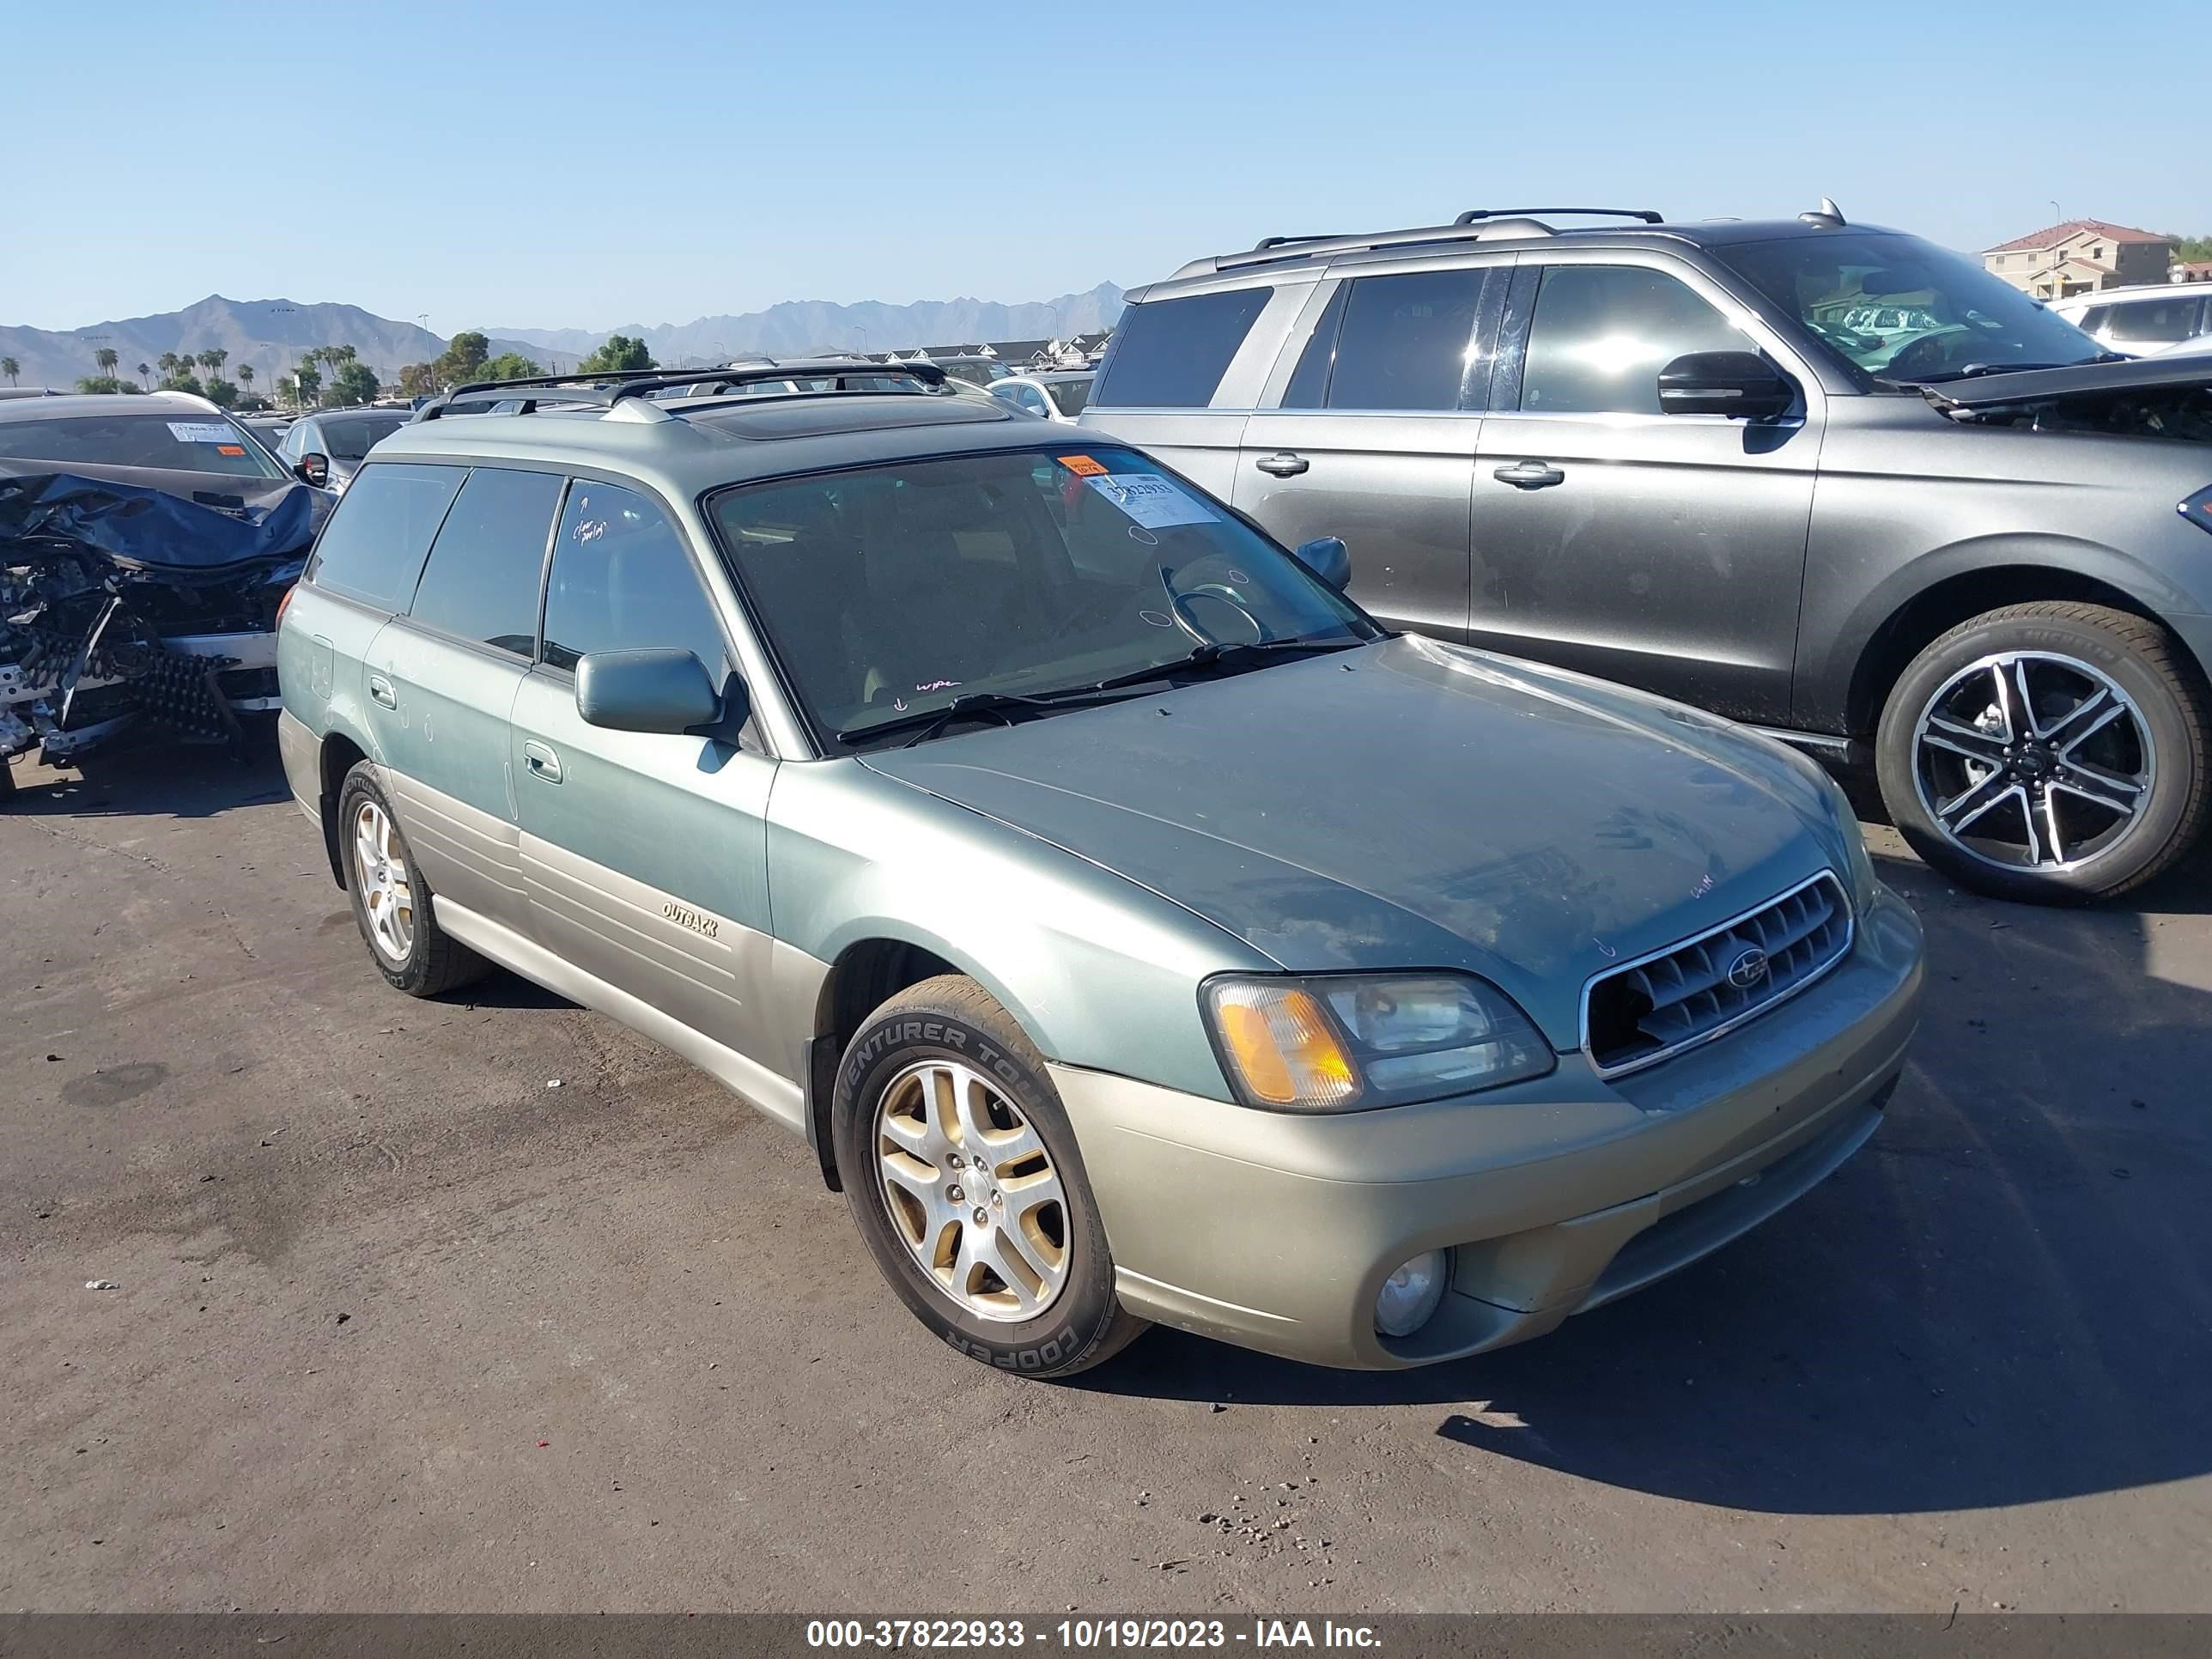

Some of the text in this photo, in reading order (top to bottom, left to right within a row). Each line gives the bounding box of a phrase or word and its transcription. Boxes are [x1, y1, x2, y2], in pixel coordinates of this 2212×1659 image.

[1107, 483, 1174, 497] 37822933
[661, 901, 719, 938] OUTBACK
[945, 1325, 1079, 1369] COOPER
